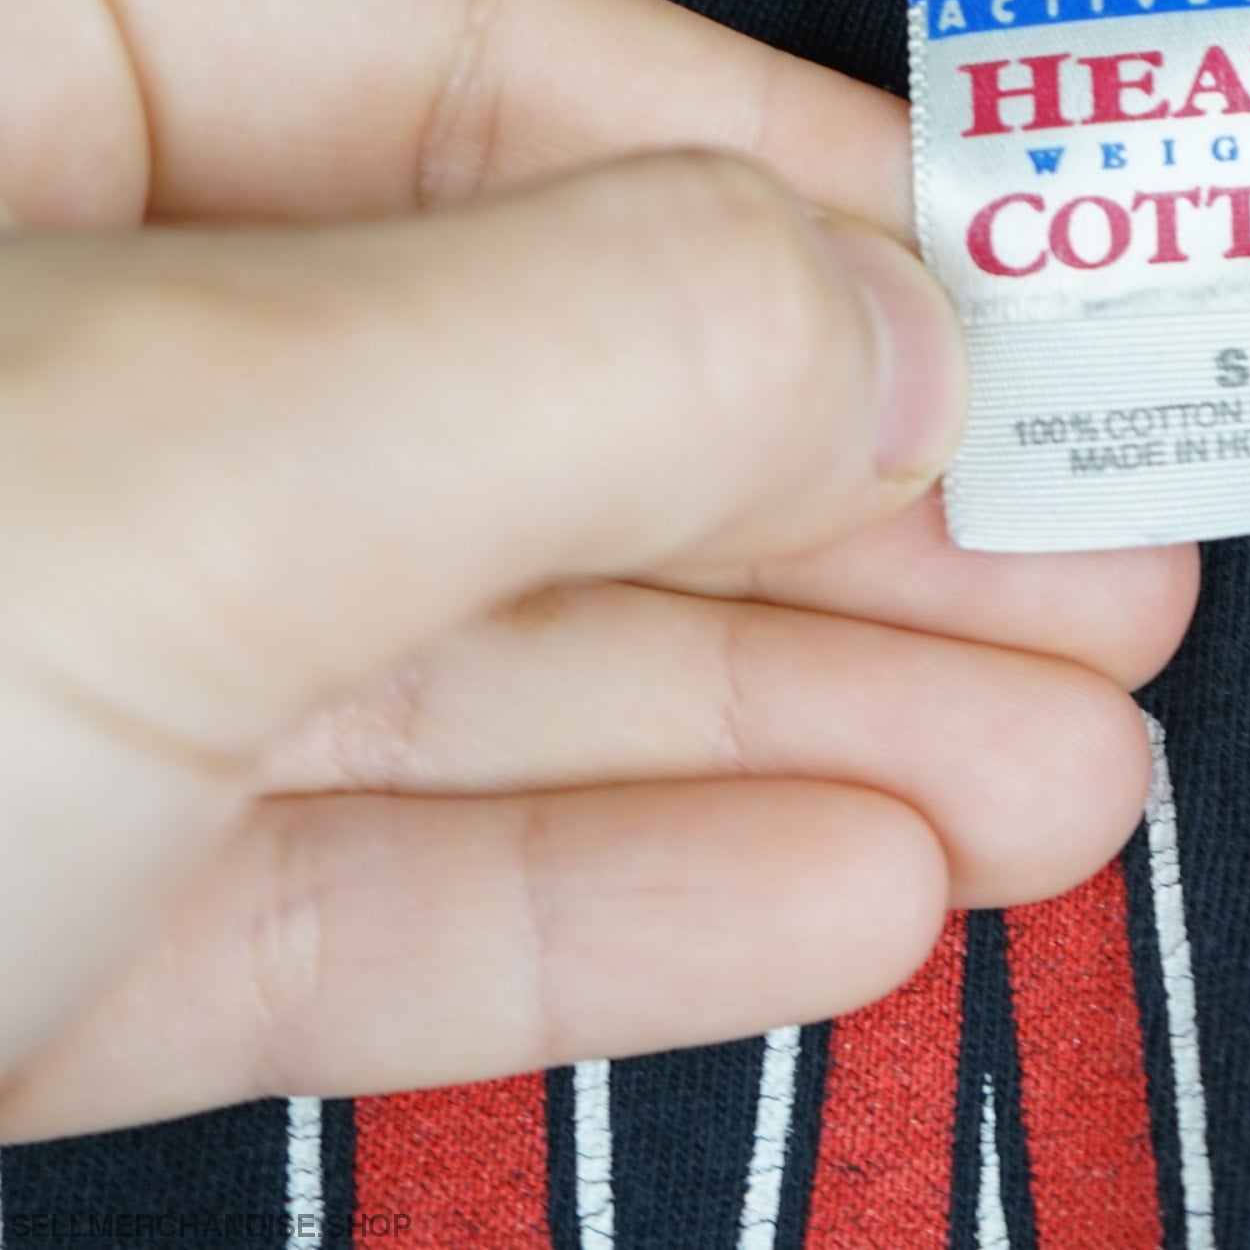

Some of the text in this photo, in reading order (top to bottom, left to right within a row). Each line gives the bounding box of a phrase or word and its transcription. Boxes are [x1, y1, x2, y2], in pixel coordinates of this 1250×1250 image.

[1213, 347, 1250, 388] S
[1013, 412, 1099, 447] 100%
[1103, 397, 1245, 440] COTTON
[1069, 441, 1168, 474] MADE
[1174, 436, 1210, 465] IN
